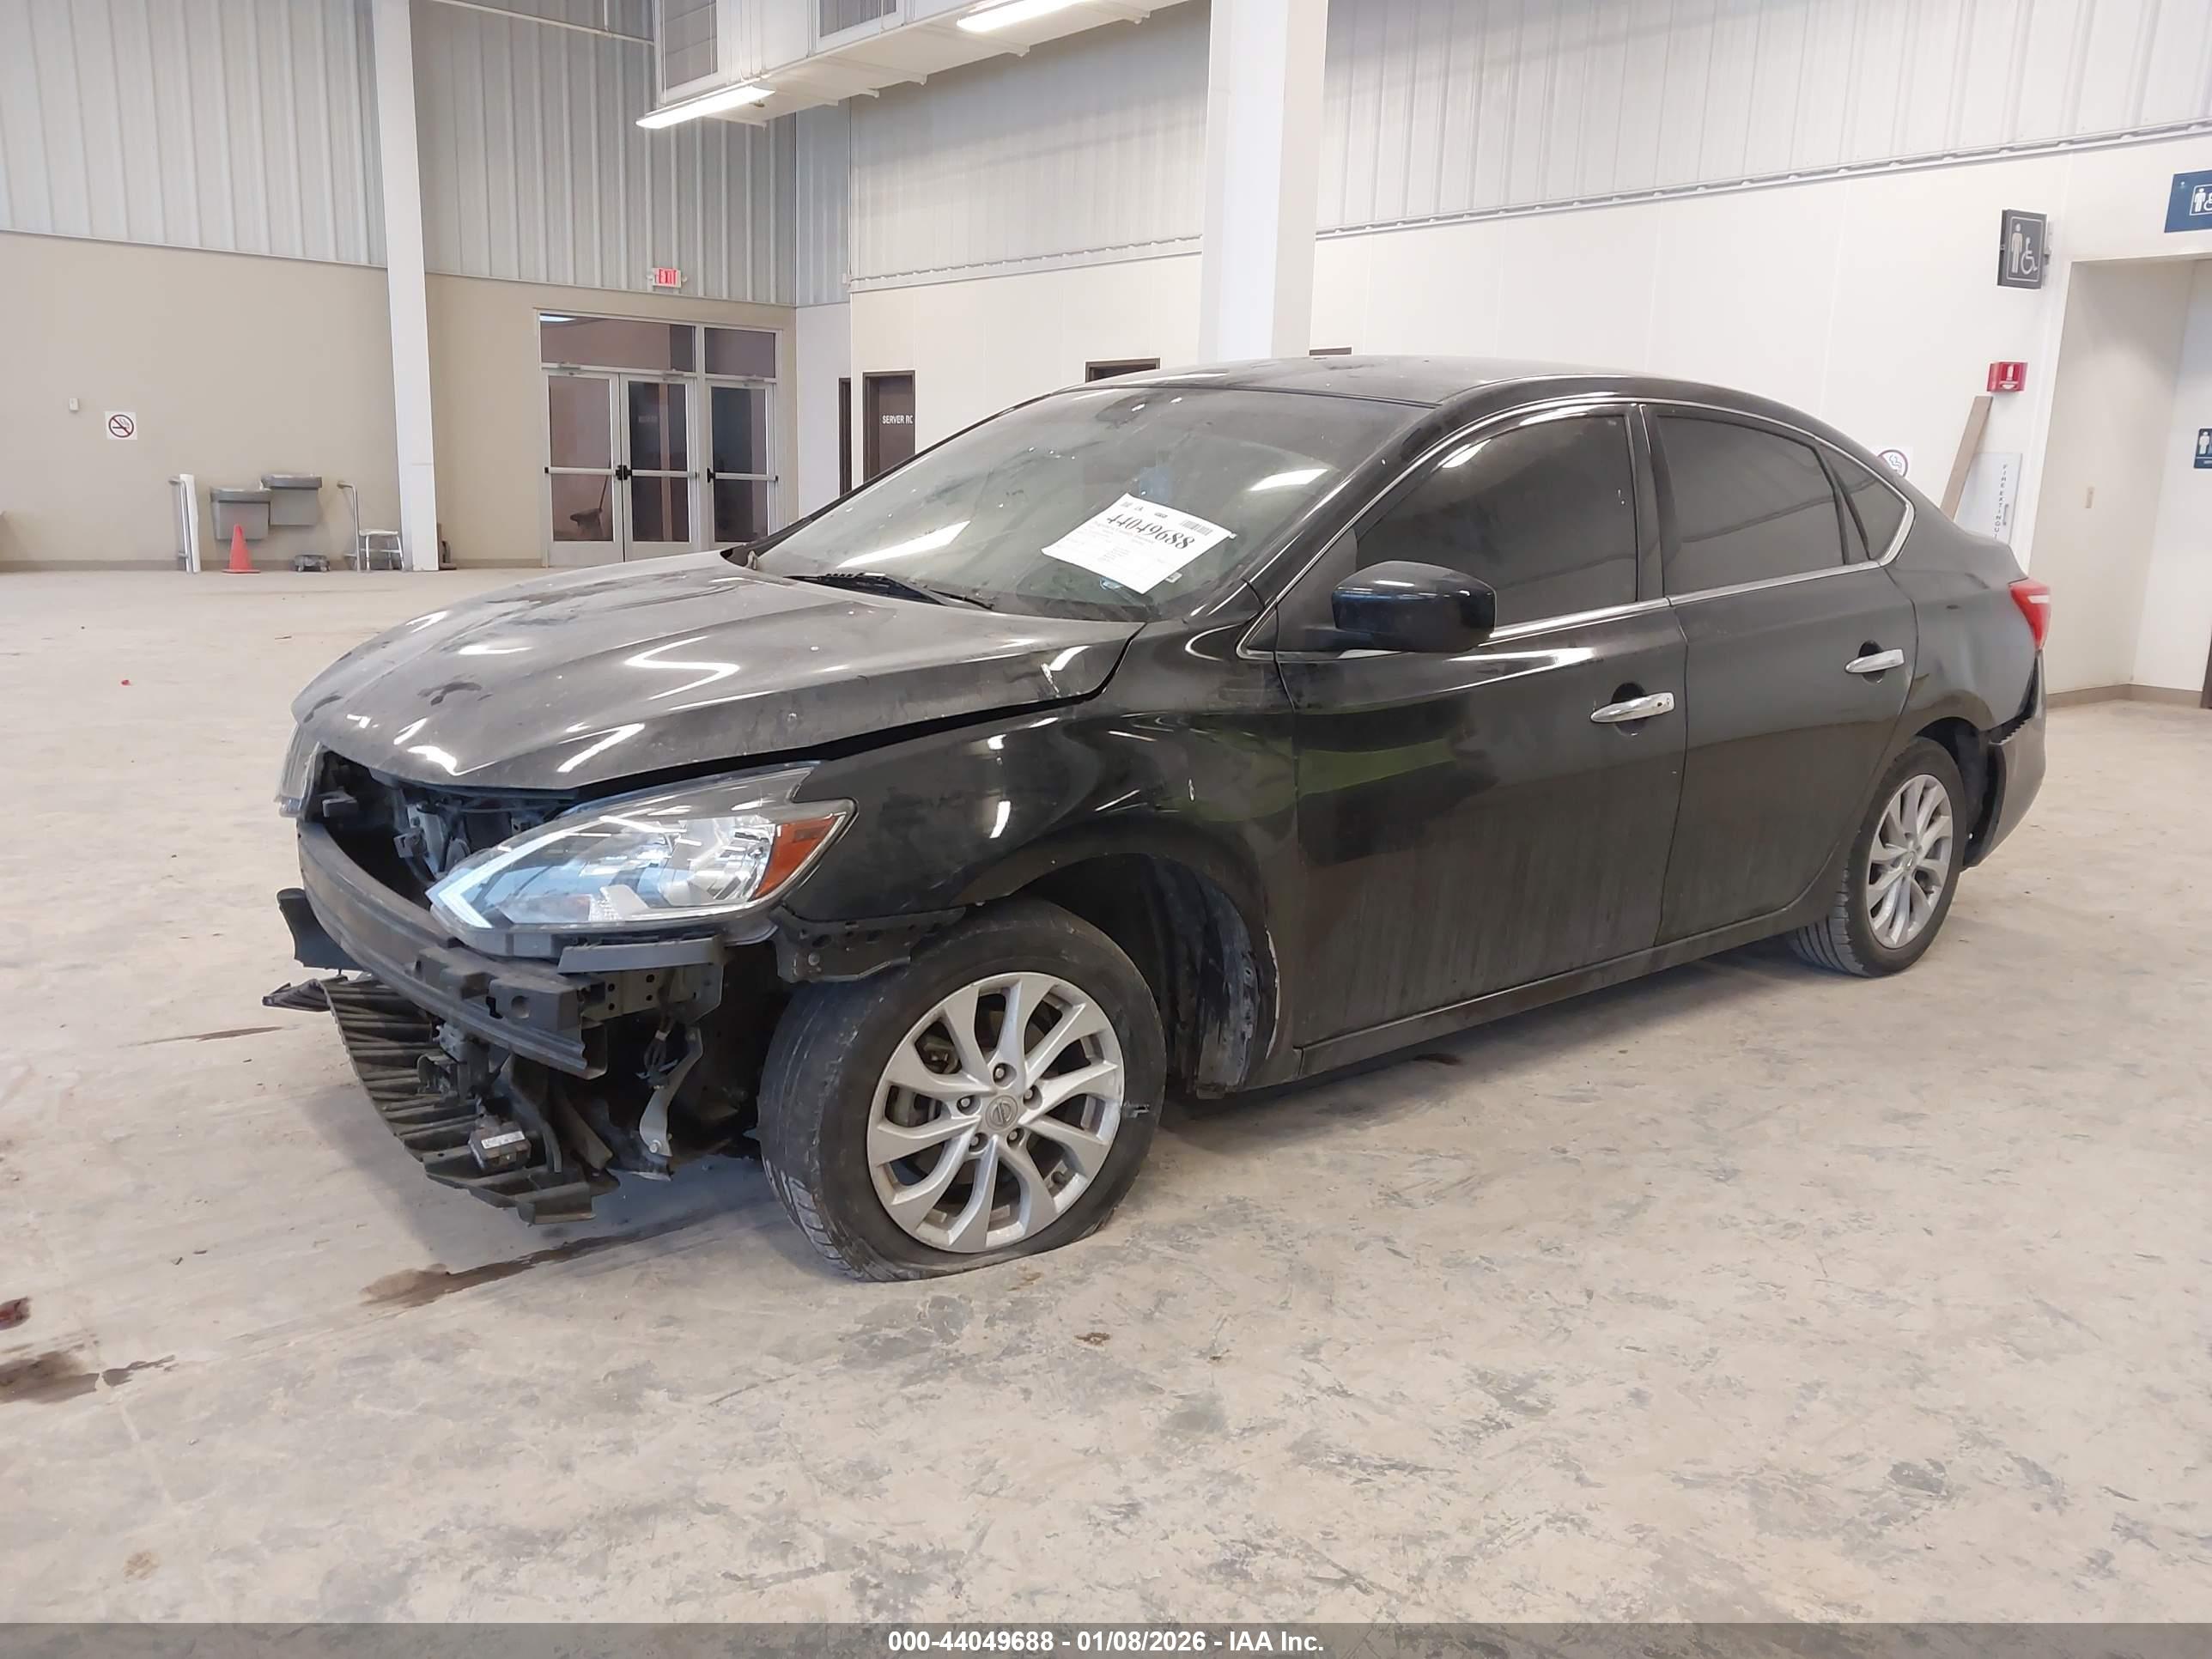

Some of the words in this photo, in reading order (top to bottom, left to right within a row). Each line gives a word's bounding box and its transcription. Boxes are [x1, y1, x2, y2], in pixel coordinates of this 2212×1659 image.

[659, 268, 677, 285] EXIT
[882, 415, 905, 424] SERVER
[1106, 514, 1195, 550] 44049688
